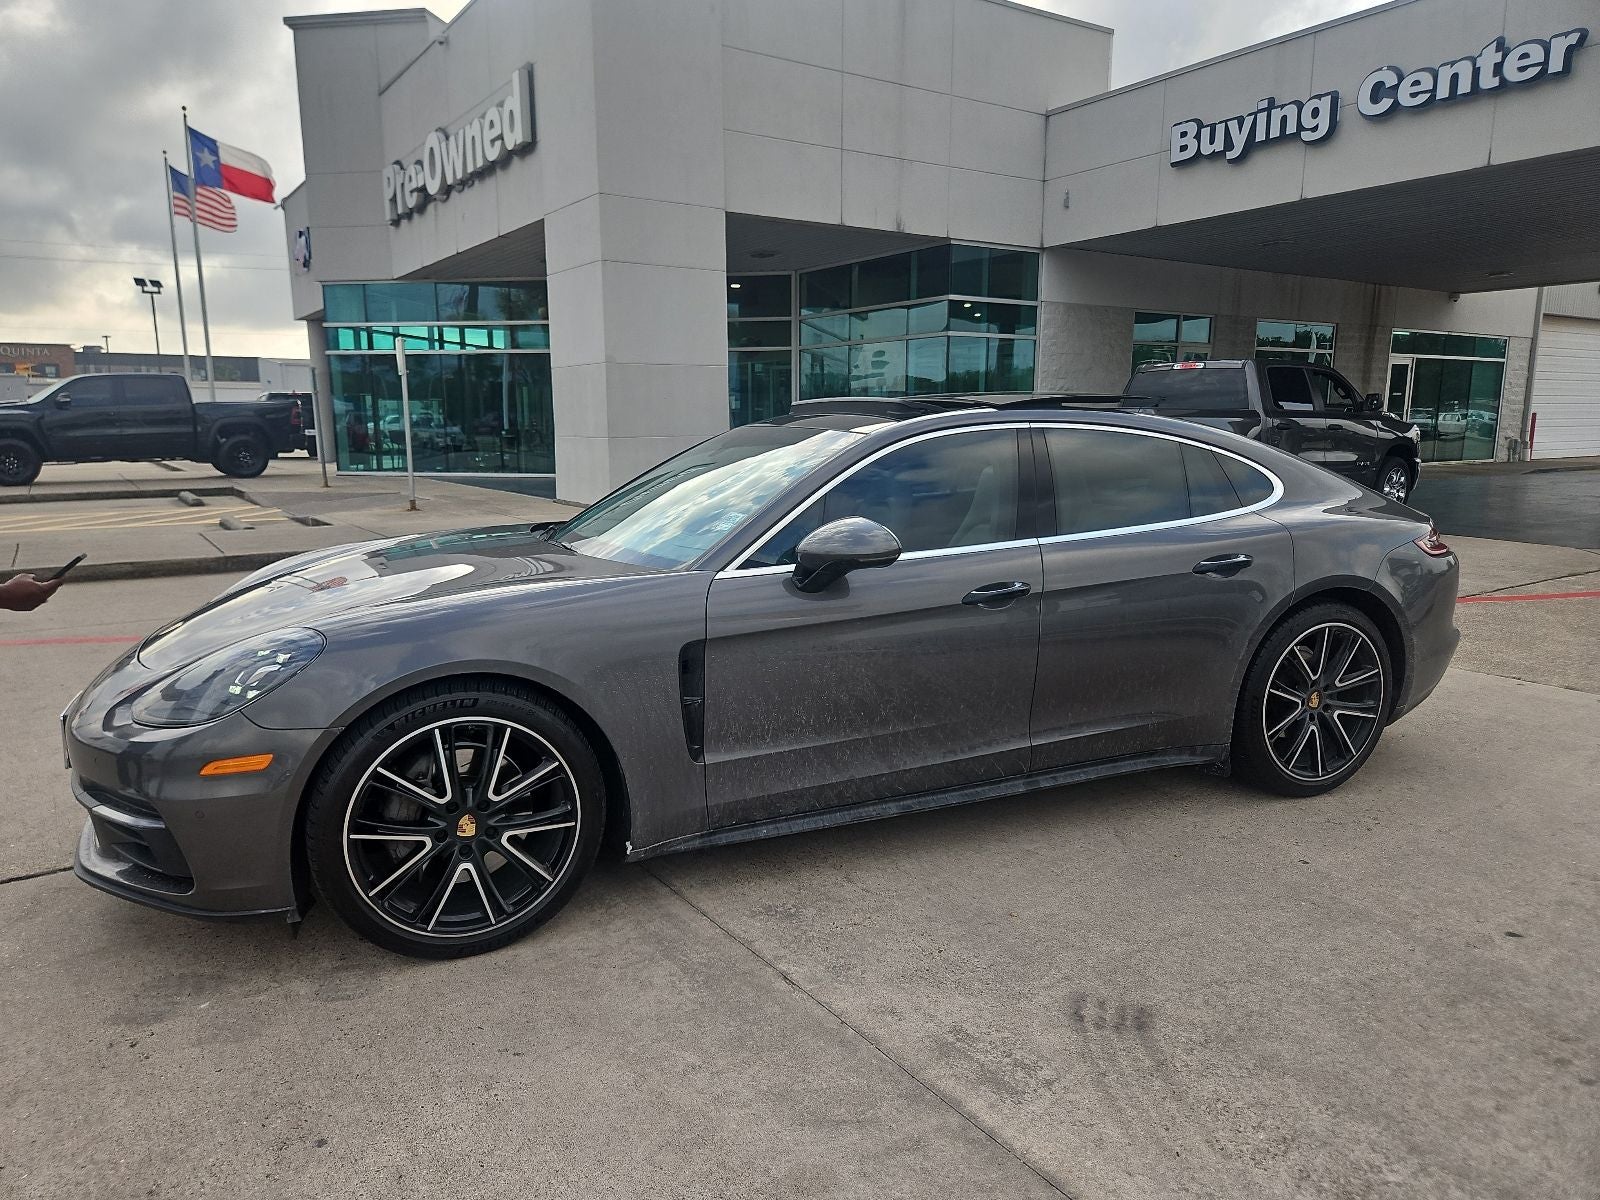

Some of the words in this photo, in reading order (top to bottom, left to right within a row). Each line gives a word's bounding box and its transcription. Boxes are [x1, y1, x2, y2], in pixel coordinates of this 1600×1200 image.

[383, 64, 534, 222] Pre-Owned
[1170, 91, 1338, 165] Buying
[1356, 30, 1585, 118] Center
[0, 345, 50, 358] QUINTA
